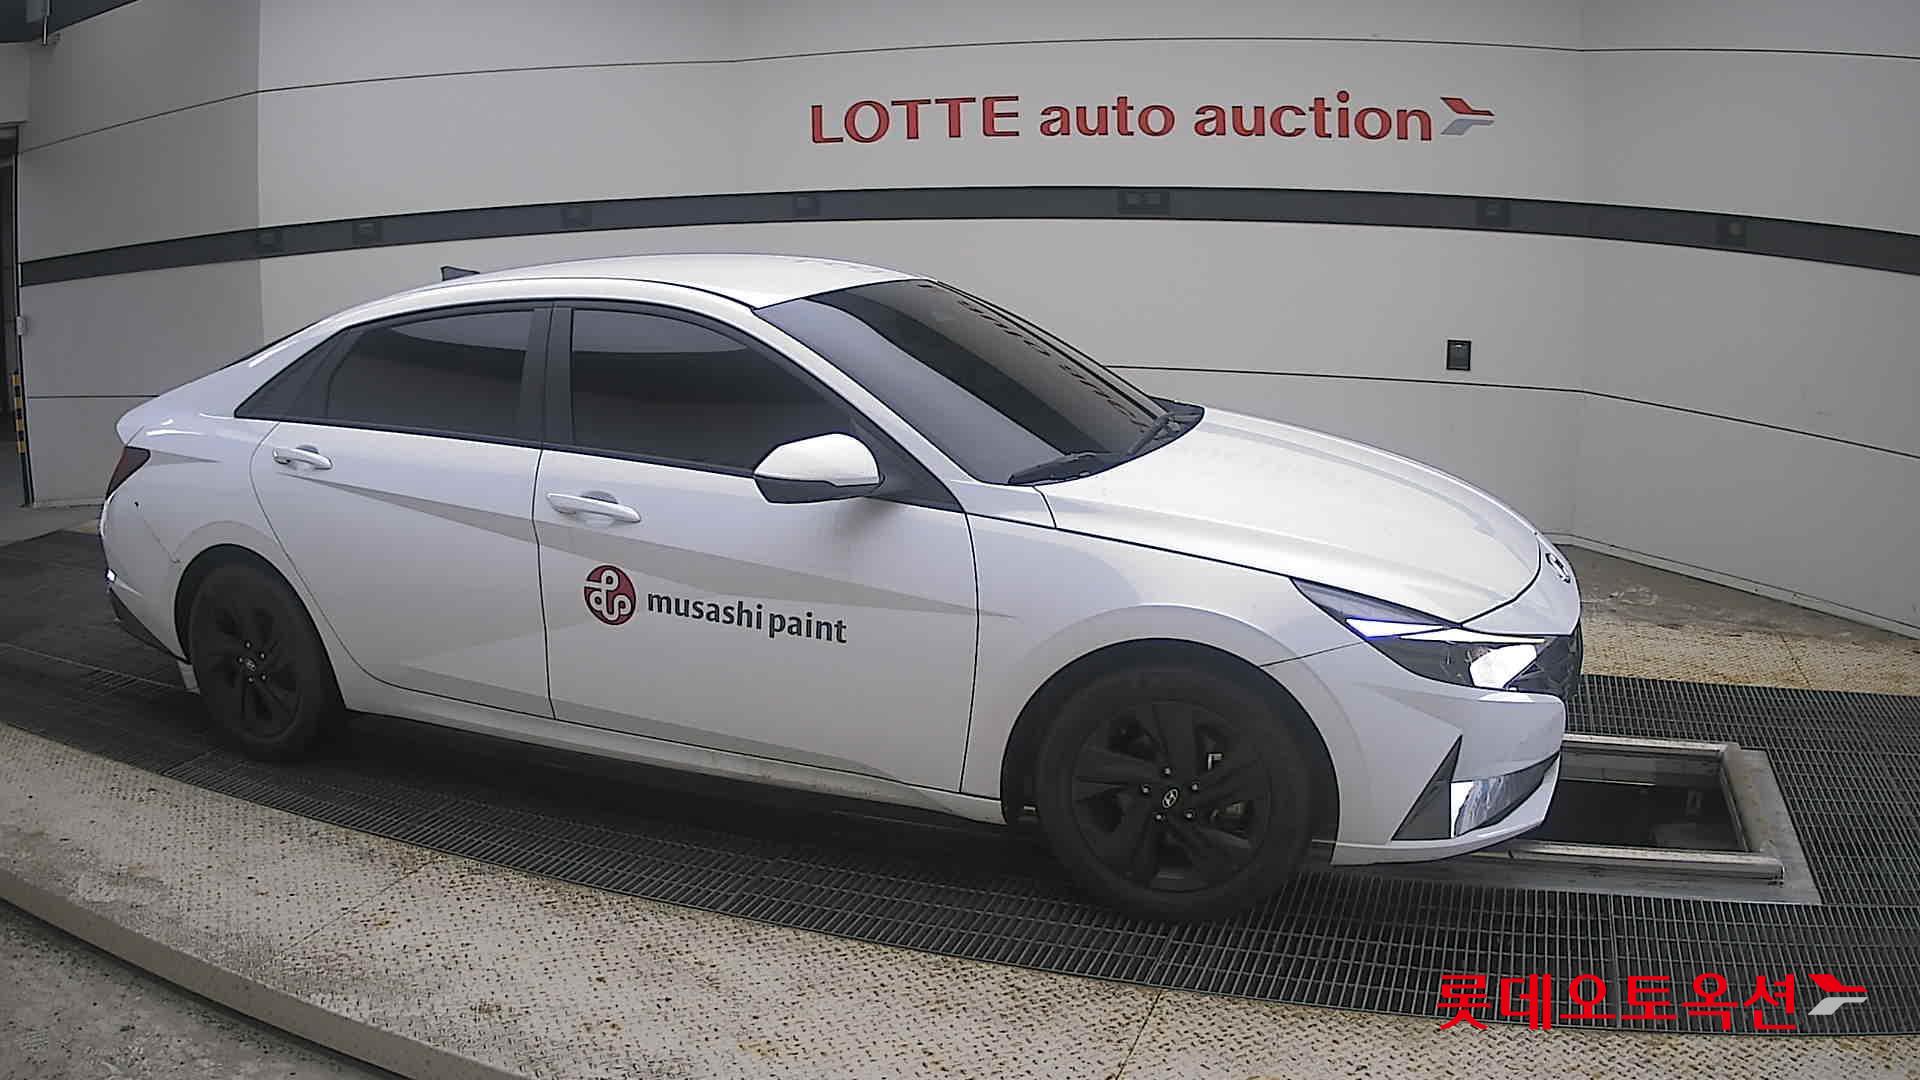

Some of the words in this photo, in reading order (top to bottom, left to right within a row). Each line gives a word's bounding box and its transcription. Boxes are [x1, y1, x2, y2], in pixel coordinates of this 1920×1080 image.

[810, 95, 1020, 144] LOTTE
[1039, 95, 1176, 138] auto
[1193, 90, 1432, 142] auction
[647, 592, 763, 630] musashi
[768, 611, 847, 644] paint
